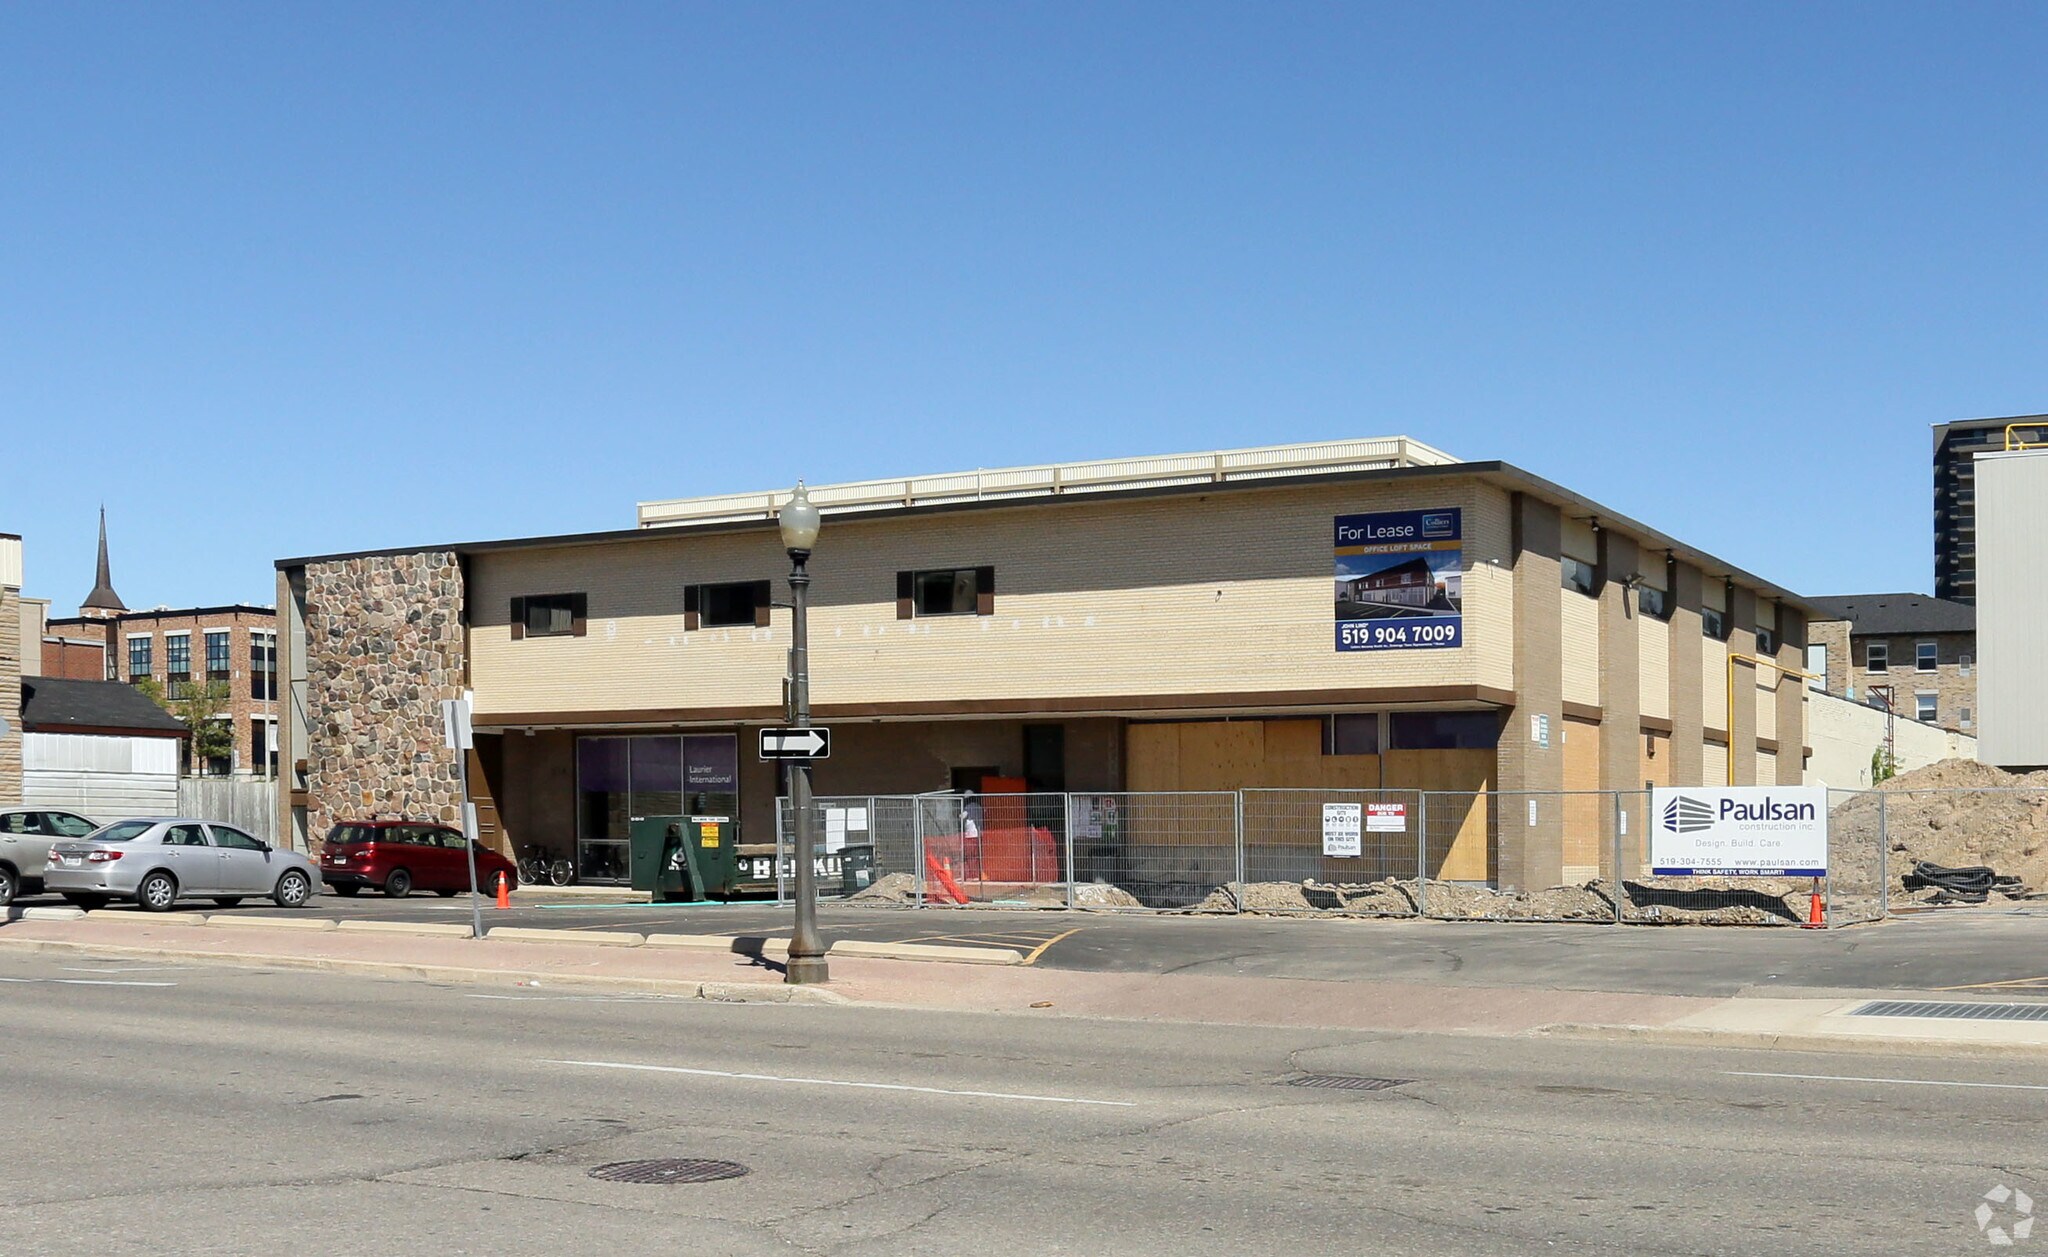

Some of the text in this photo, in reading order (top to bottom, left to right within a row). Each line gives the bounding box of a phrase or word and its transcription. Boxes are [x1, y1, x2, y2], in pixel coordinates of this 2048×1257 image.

[1339, 524, 1414, 540] For Lease
[1364, 543, 1432, 553] OFFICE LOFT SPACE
[1343, 625, 1455, 644] 519 904 7009
[689, 765, 712, 774] Laurier
[689, 774, 731, 784] International
[1720, 796, 1815, 821] Paulsan
[1739, 822, 1816, 831] construction inc.
[1695, 839, 1784, 849] Design. Build. Care.
[1660, 857, 1819, 867] 519-304-7555 www.paulsan.com
